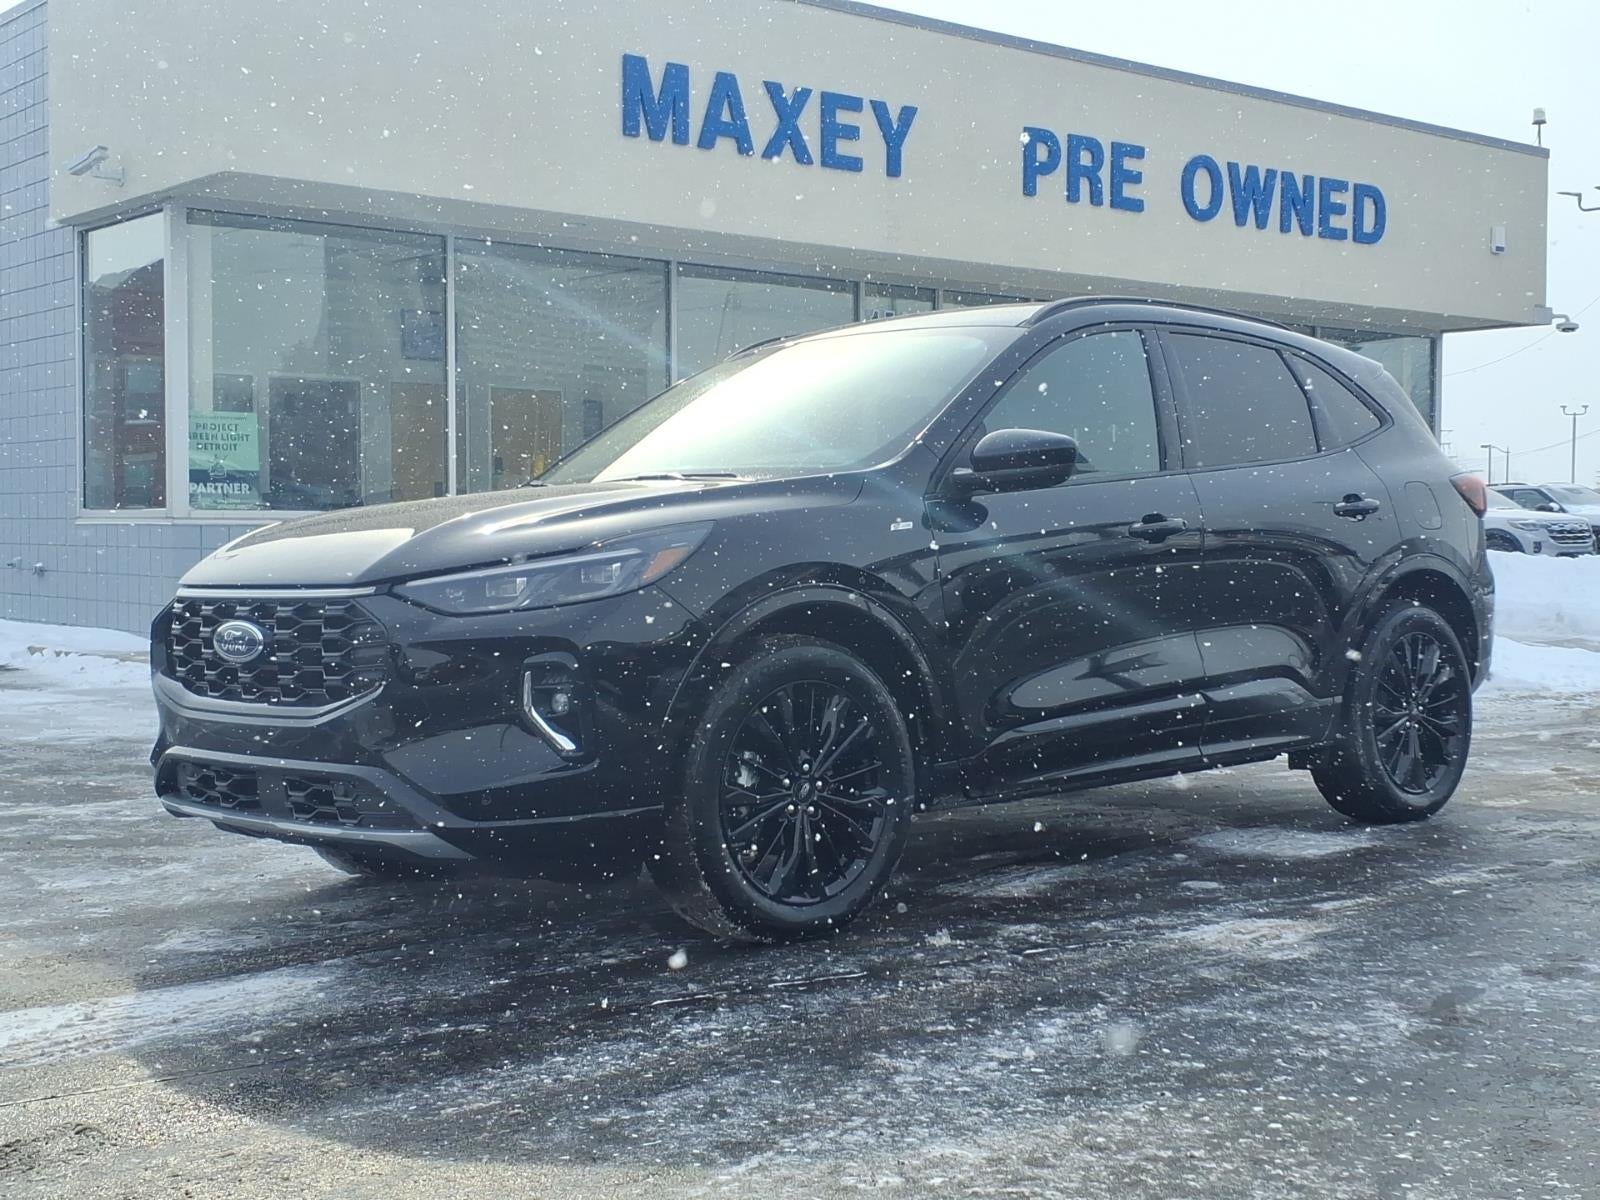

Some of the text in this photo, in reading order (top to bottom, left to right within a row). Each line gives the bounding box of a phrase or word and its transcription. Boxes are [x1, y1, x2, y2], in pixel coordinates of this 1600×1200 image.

[622, 53, 1387, 245] MAXEY PRE OWNED
[195, 422, 239, 432] PROJECT
[189, 431, 250, 442] REEN LIGHT
[196, 442, 238, 451] DETROIT
[189, 481, 250, 494] PARTNER
